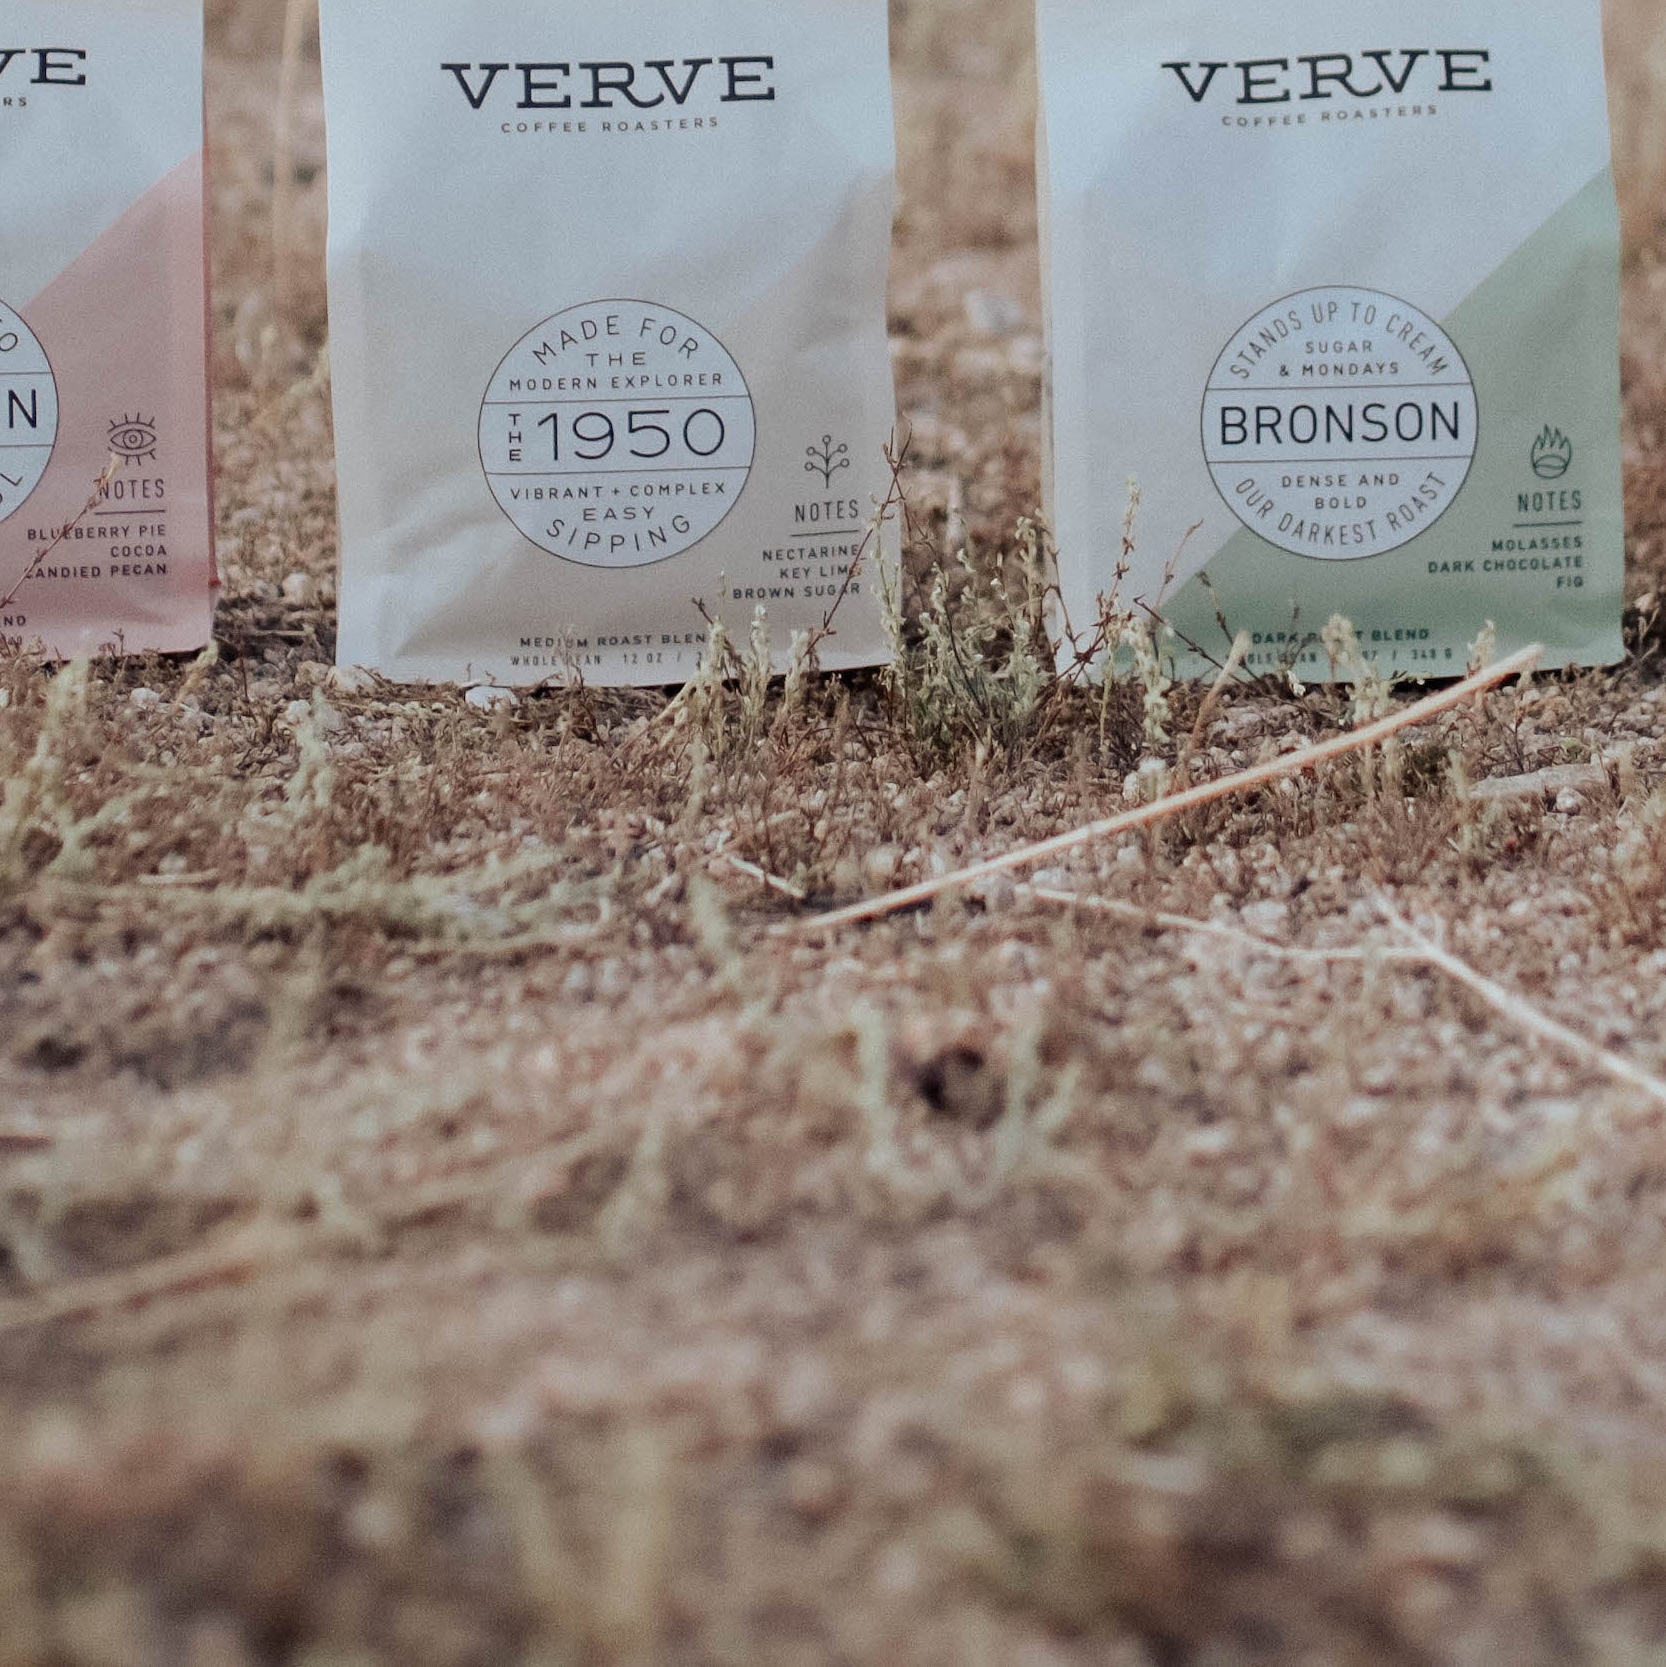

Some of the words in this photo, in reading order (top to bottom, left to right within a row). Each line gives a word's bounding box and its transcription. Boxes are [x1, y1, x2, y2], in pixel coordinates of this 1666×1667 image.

[441, 56, 775, 109] VERVE
[1161, 50, 1492, 103] VERVE
[1222, 114, 1306, 127] COFFEE
[1321, 105, 1437, 121] ROASTERS
[502, 122, 586, 133] COFFEE
[603, 117, 718, 132] ROASTERS
[533, 315, 619, 365] MADE
[640, 318, 698, 359] FOR
[1230, 311, 1302, 380] STANDS
[1311, 302, 1338, 323] UP
[1351, 302, 1376, 325] TO
[1386, 313, 1449, 376] CREAM
[1305, 340, 1373, 354] SUGAR
[587, 352, 646, 367] THE
[1279, 365, 1289, 377] &
[1302, 362, 1399, 375] MONDAYS
[510, 378, 597, 391] MODERN
[612, 373, 722, 388] EXPLORER
[1221, 401, 1459, 445] BRONSON
[509, 413, 522, 461] THE
[538, 408, 725, 460] 1950
[1282, 474, 1347, 488] DENSE
[1359, 473, 1399, 486] AND
[100, 479, 164, 499] NOTES
[510, 486, 603, 500] VIBRANT
[630, 483, 725, 496] COMPLEX
[1236, 478, 1274, 518] OUR
[1277, 513, 1377, 545] DARKEST
[1386, 471, 1446, 532] ROAST
[1315, 497, 1366, 509] BOLD
[1518, 490, 1581, 512] NOTES
[584, 507, 654, 521] EASY
[795, 499, 858, 522] NOTES
[27, 526, 134, 540] BLUEBERRY
[140, 524, 166, 536] PIE
[546, 515, 690, 553] SIPPING
[111, 545, 167, 557] COCOA
[1492, 536, 1582, 551] MOLASSES
[763, 544, 859, 561] NECTARINE
[111, 564, 167, 576] PECAN
[780, 567, 810, 579] KEY
[820, 565, 853, 577] LIM
[1429, 561, 1475, 573] DARK
[1483, 556, 1582, 572] CHOCOLATE
[1556, 576, 1583, 588] FIG
[733, 588, 794, 599] BROWN
[597, 634, 652, 646] ROAST
[662, 634, 709, 644] BLEN
[1372, 629, 1429, 641] BLEND
[511, 655, 557, 666] WHOLE
